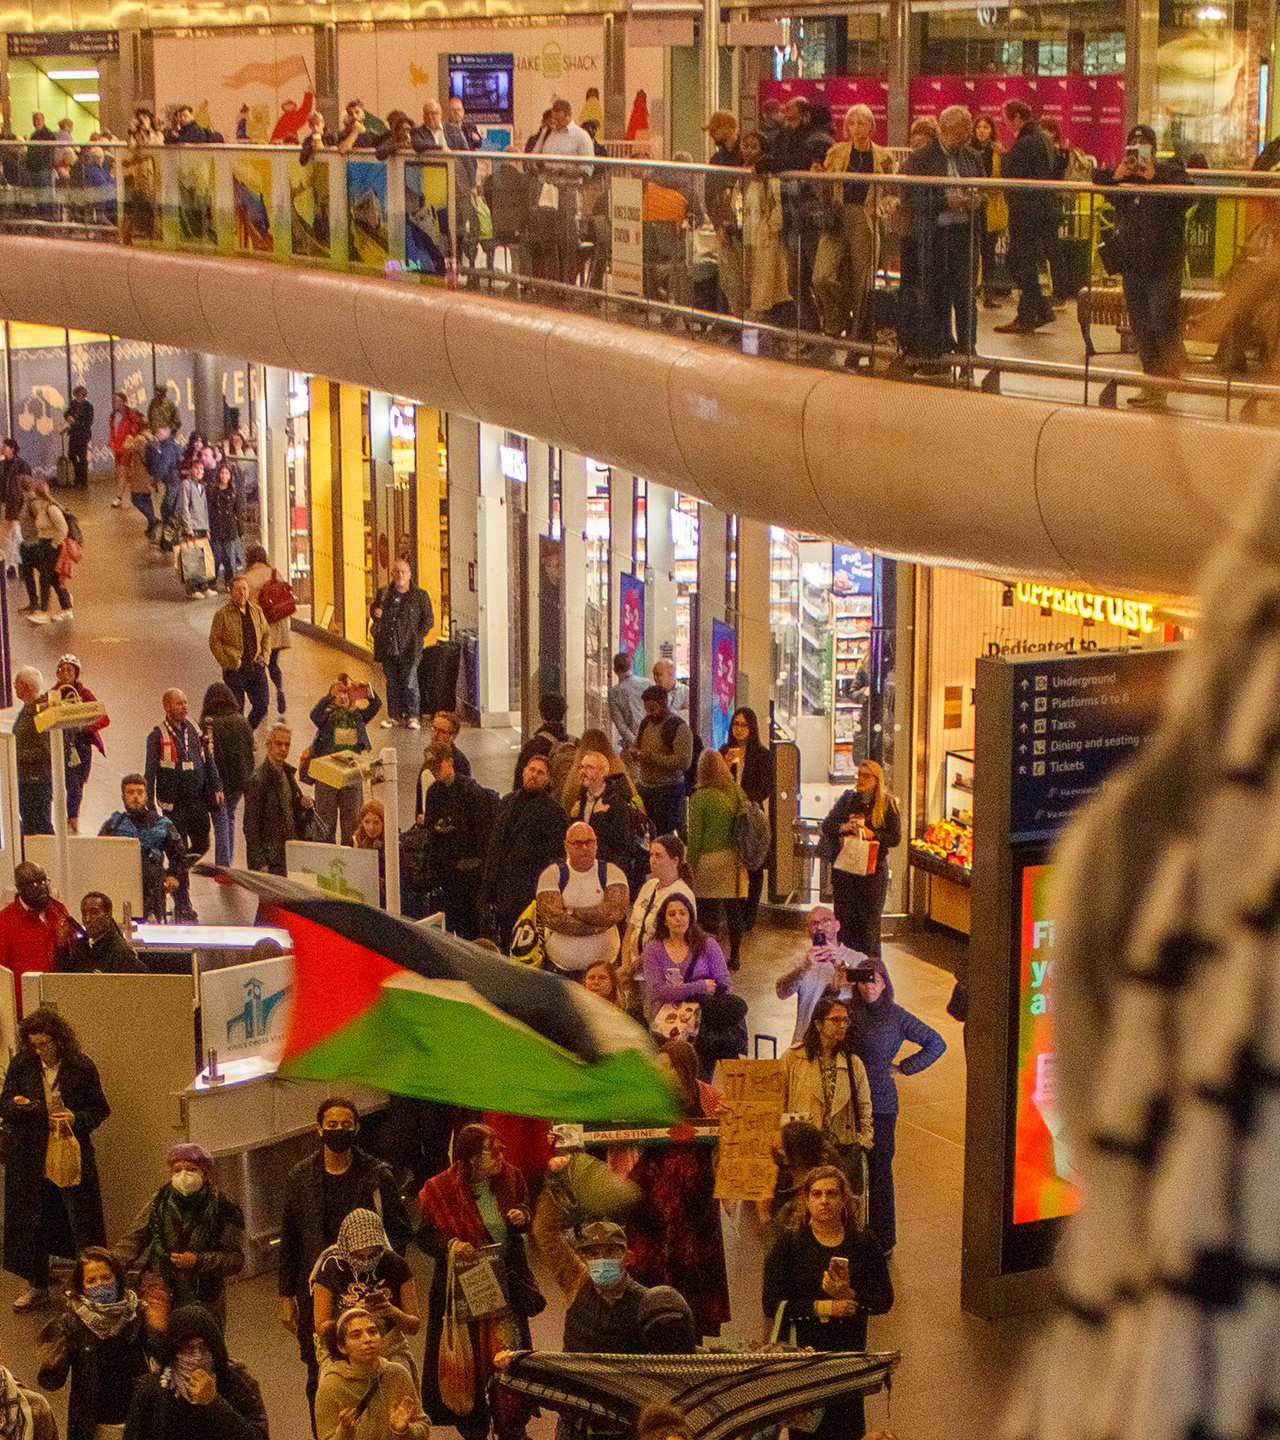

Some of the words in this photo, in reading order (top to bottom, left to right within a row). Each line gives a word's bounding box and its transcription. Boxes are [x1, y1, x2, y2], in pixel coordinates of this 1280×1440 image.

[515, 56, 540, 70] HAKE
[563, 55, 597, 71] SHACK
[1052, 672, 1117, 688] Underground
[1052, 696, 1099, 709] Platforms
[1051, 719, 1076, 730] Taxis
[1050, 740, 1082, 752] Dining
[1084, 737, 1103, 748] and
[1104, 735, 1140, 748] seating
[1050, 761, 1085, 773] Tickets
[511, 925, 535, 949] JD
[593, 1129, 656, 1140] PALESTINE
